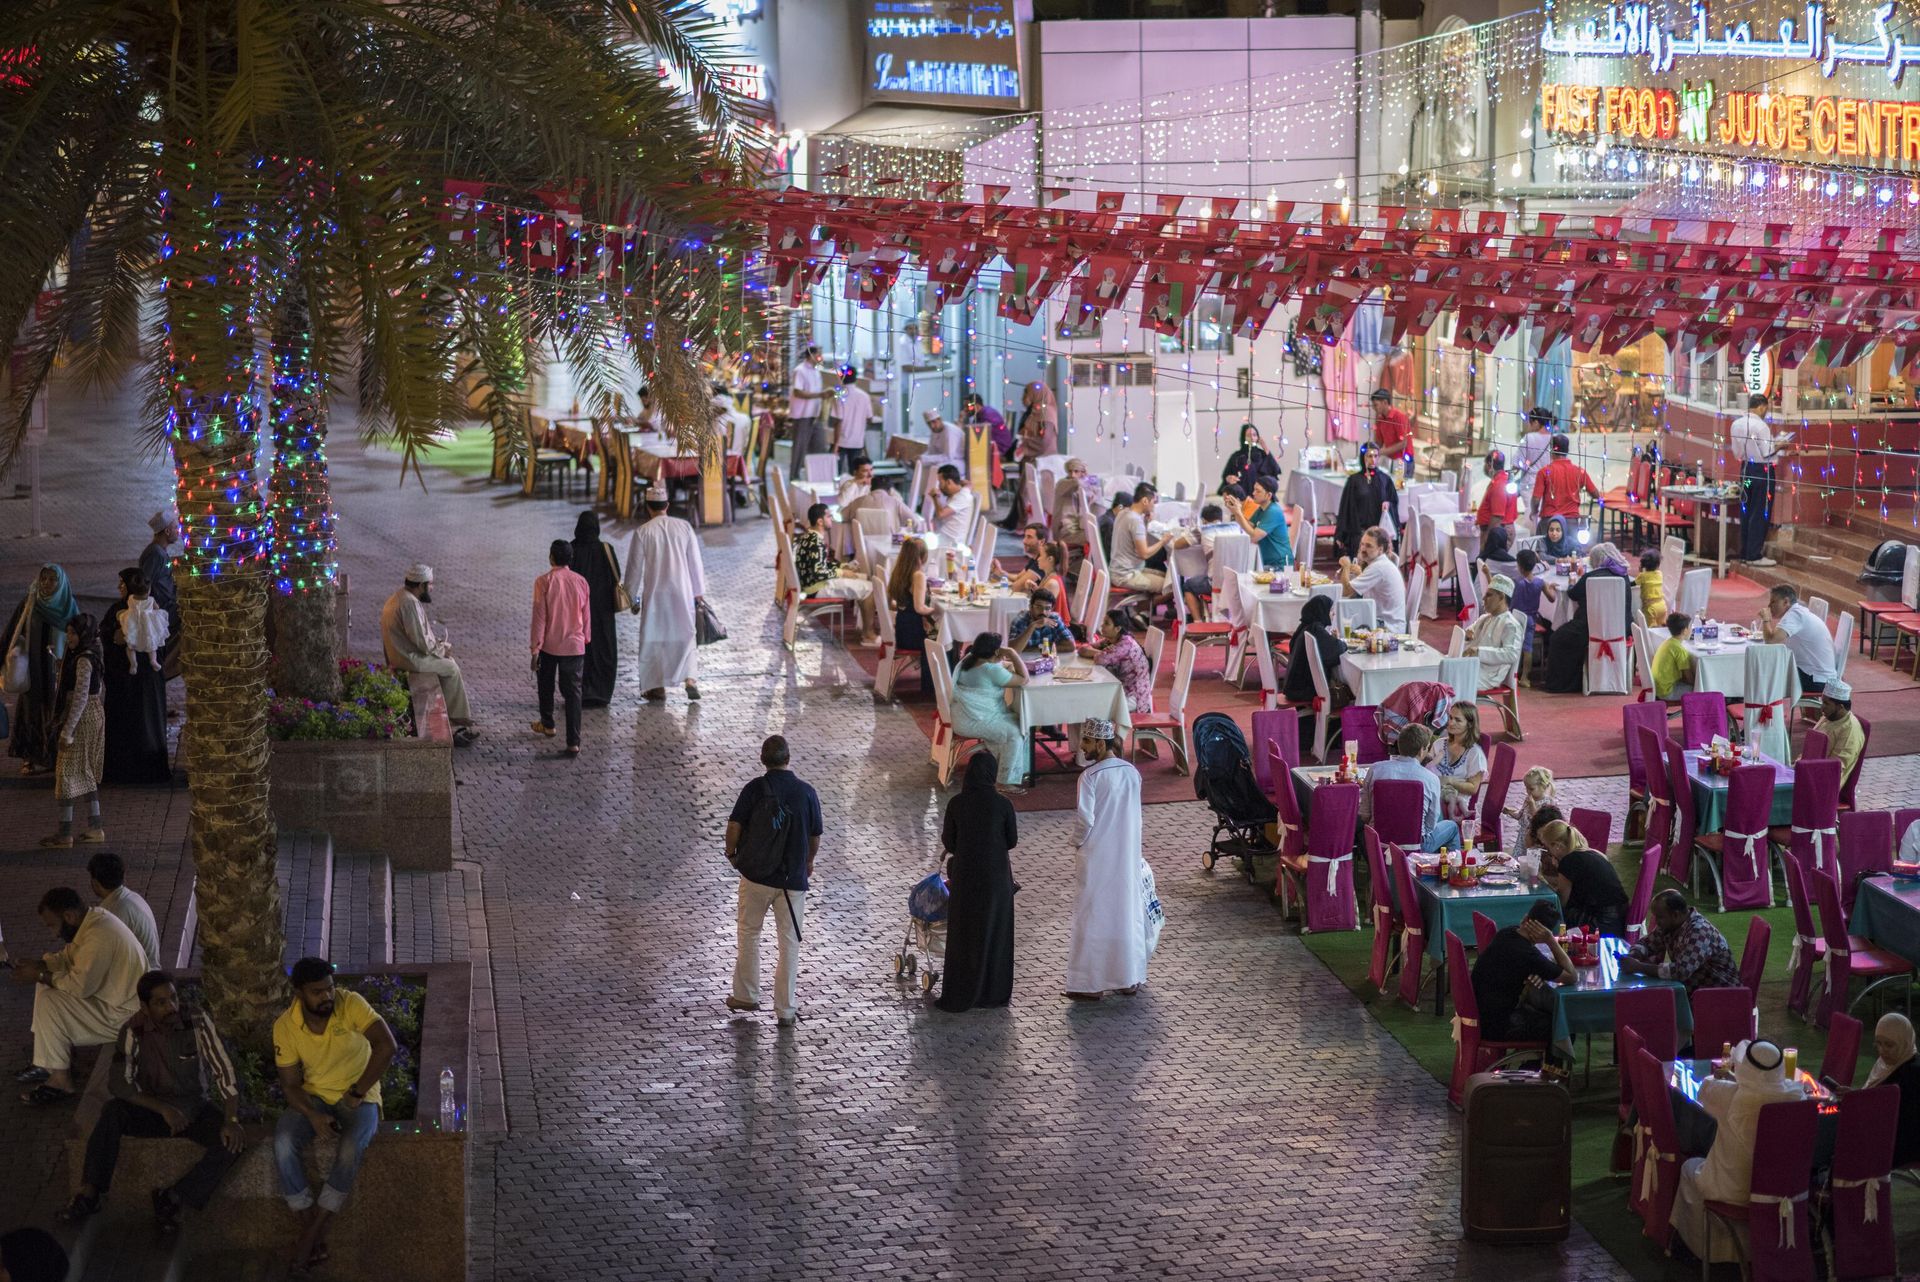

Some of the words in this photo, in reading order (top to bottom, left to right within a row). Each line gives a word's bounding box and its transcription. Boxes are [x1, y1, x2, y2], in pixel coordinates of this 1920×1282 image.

[1821, 1, 1920, 82] ركز
[1541, 83, 1599, 135] FAST
[1605, 86, 1677, 139] FOOD
[1719, 91, 1808, 151] JUICE
